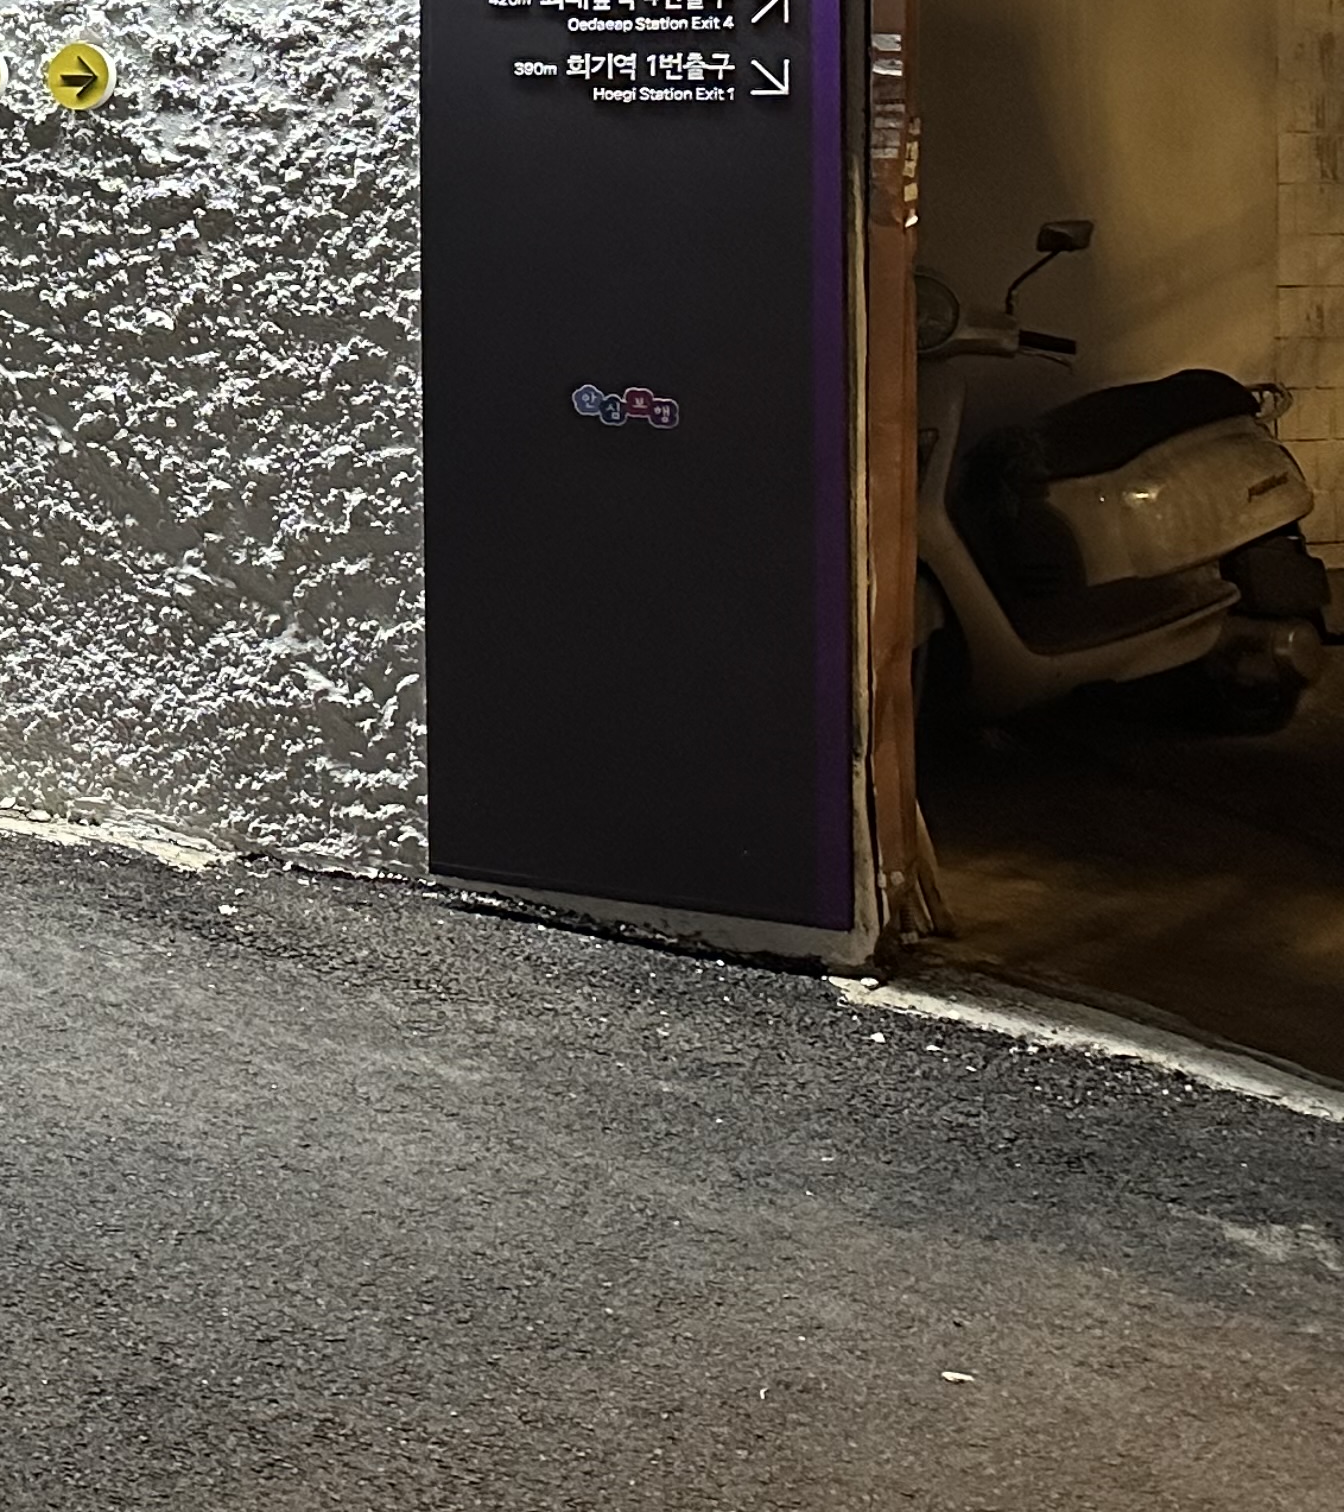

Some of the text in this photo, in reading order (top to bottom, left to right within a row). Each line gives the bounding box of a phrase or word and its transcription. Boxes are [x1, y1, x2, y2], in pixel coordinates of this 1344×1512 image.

[635, 18, 688, 30] Station
[692, 16, 720, 29] Exit
[723, 16, 734, 29] 4
[514, 52, 735, 81] 390m 회기역 1번출구
[593, 87, 735, 102] Hoegi Station Exit 1
